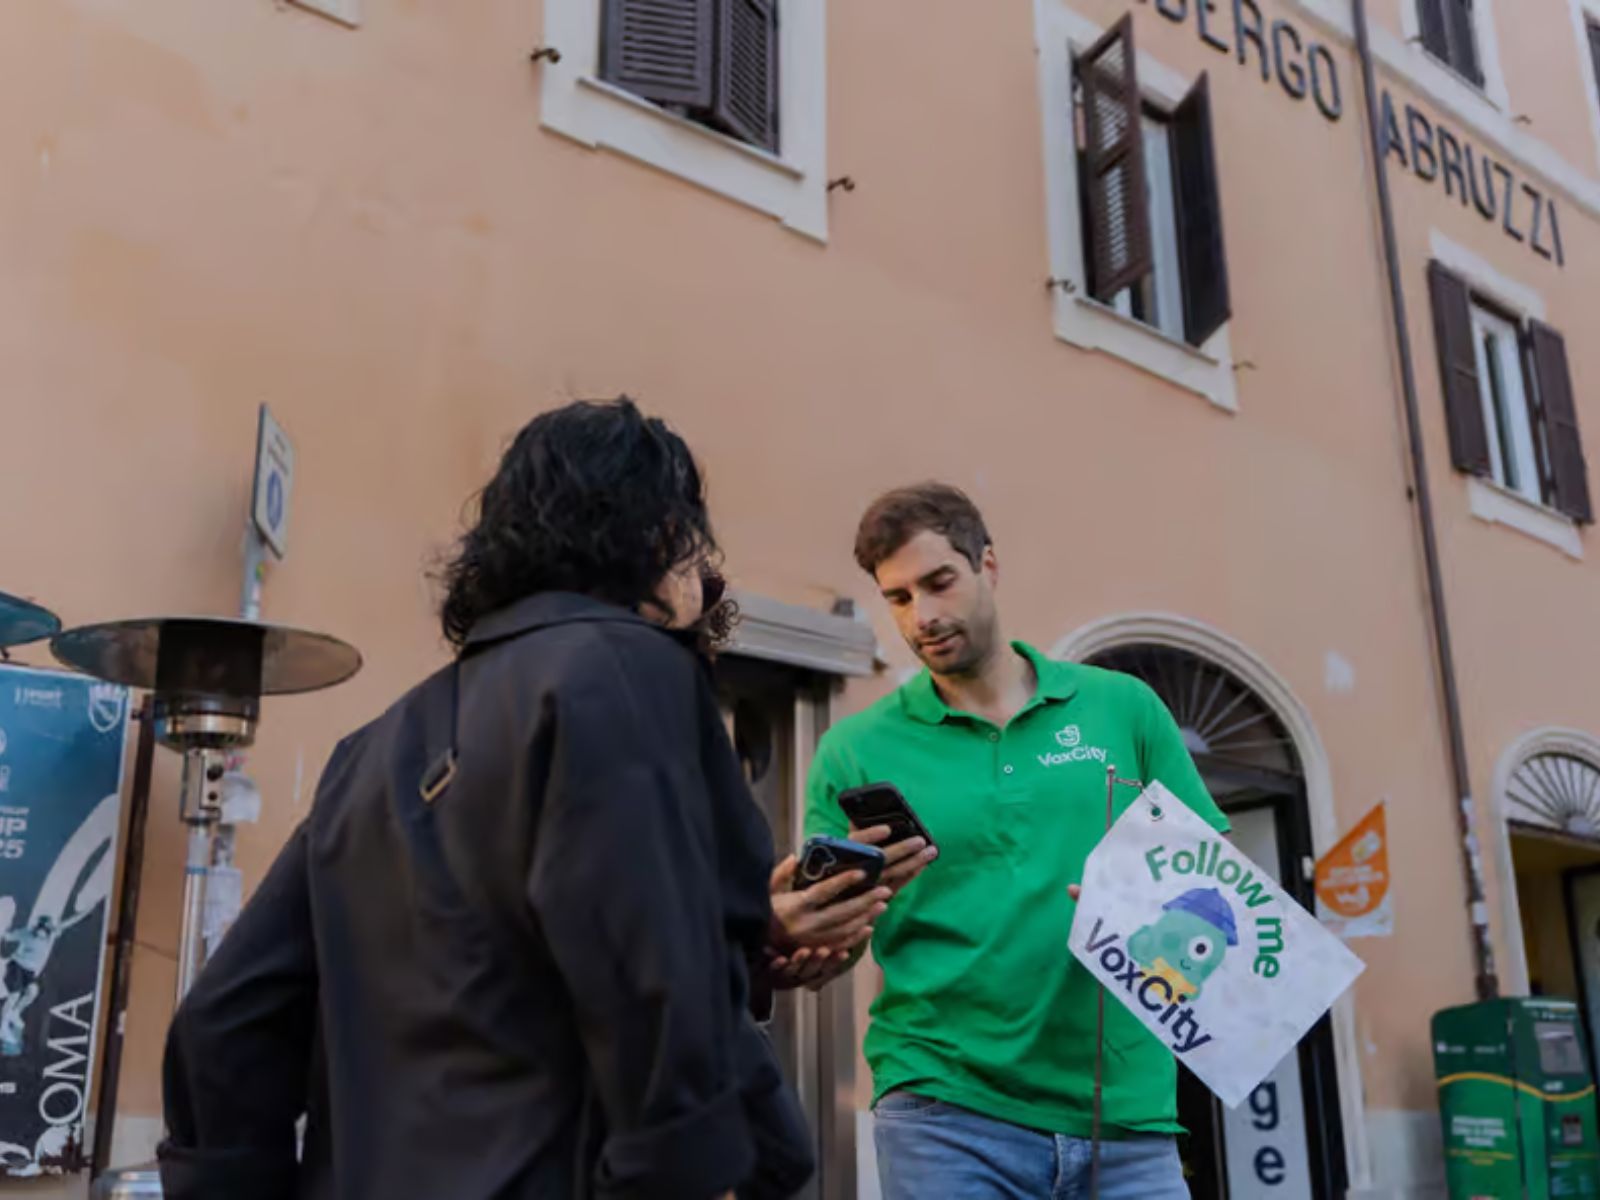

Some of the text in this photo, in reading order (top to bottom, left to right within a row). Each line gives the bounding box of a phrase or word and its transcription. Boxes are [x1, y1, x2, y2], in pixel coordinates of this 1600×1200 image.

[1379, 90, 1565, 267] ABRUZZI
[1037, 745, 1106, 767] VoxCity
[1145, 841, 1285, 979] Follow me
[1085, 917, 1212, 1053] VoxCity
